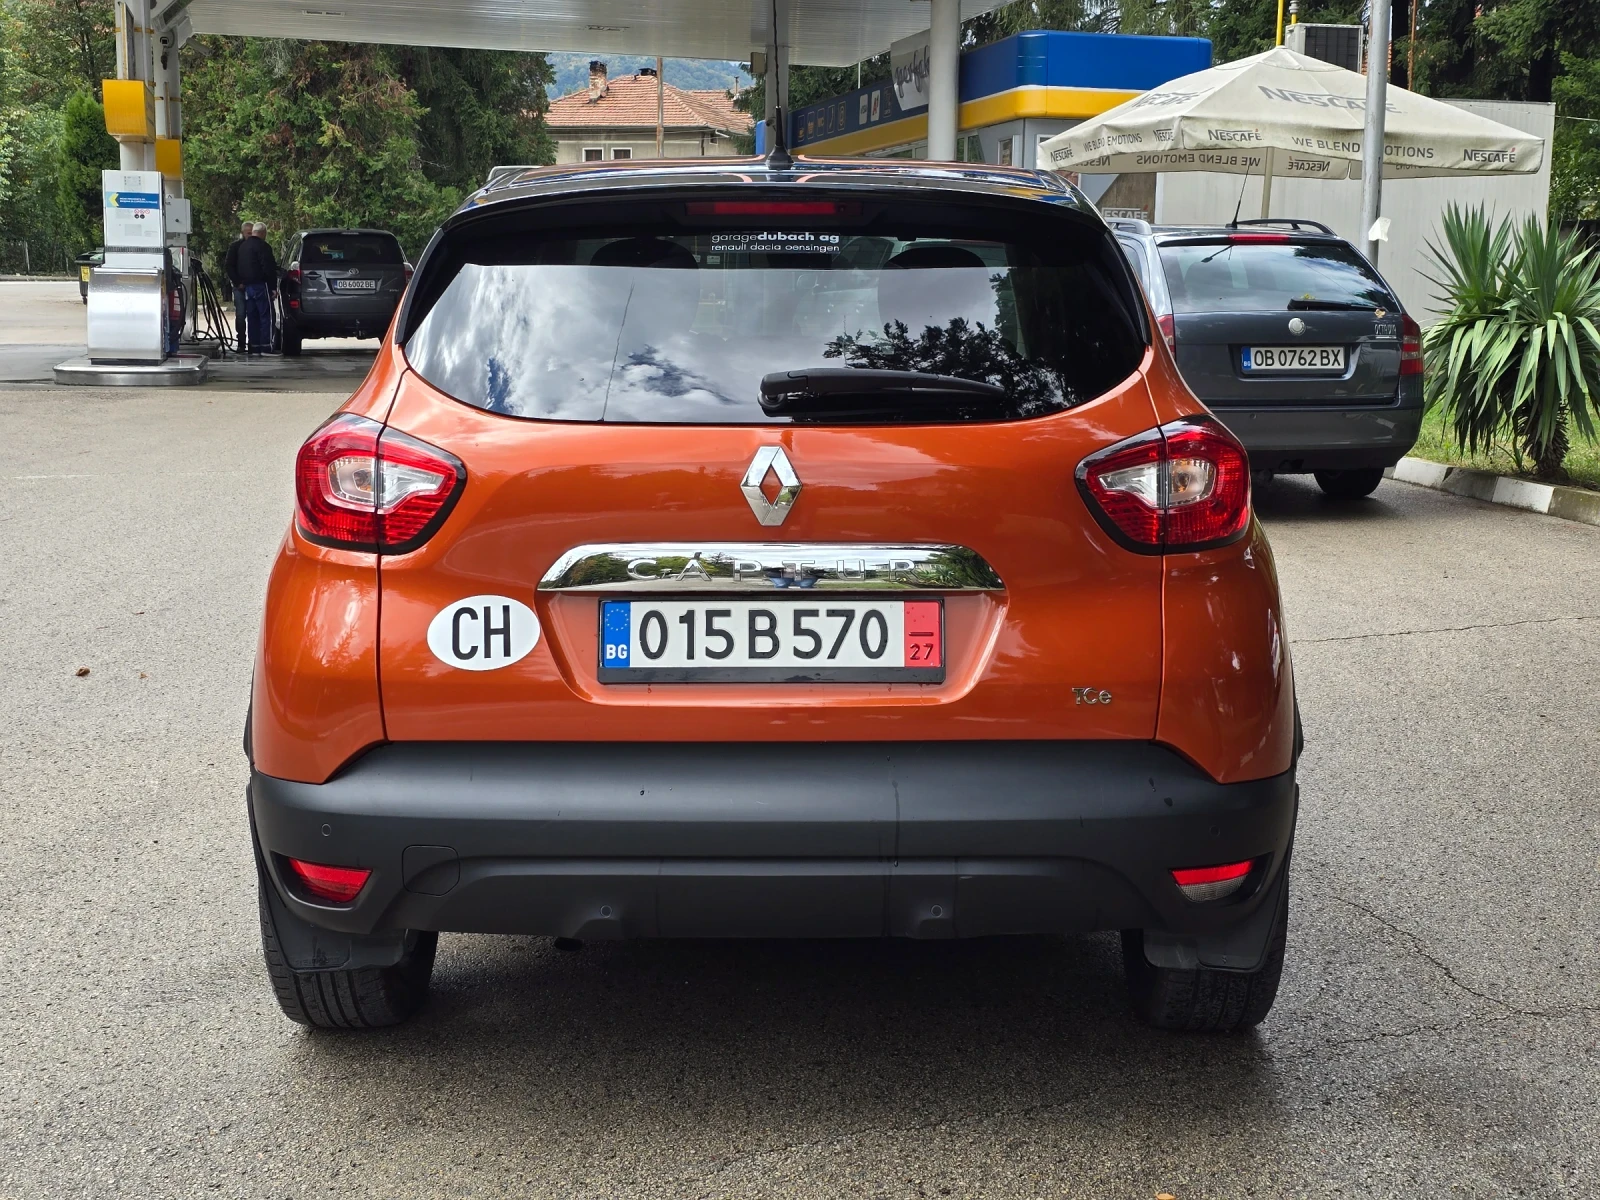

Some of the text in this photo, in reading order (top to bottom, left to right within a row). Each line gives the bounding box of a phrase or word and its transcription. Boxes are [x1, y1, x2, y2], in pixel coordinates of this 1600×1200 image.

[1107, 133, 1143, 146] EMOTIONS
[1292, 136, 1434, 159] WE BLEND OTIONS
[711, 242, 840, 253] renault dacia oensingen
[819, 234, 840, 244] ag
[626, 557, 919, 582] CAPTUR
[452, 605, 512, 660] CH
[605, 643, 628, 660] BG
[909, 643, 934, 660] 27
[1072, 687, 1112, 705] TCe
